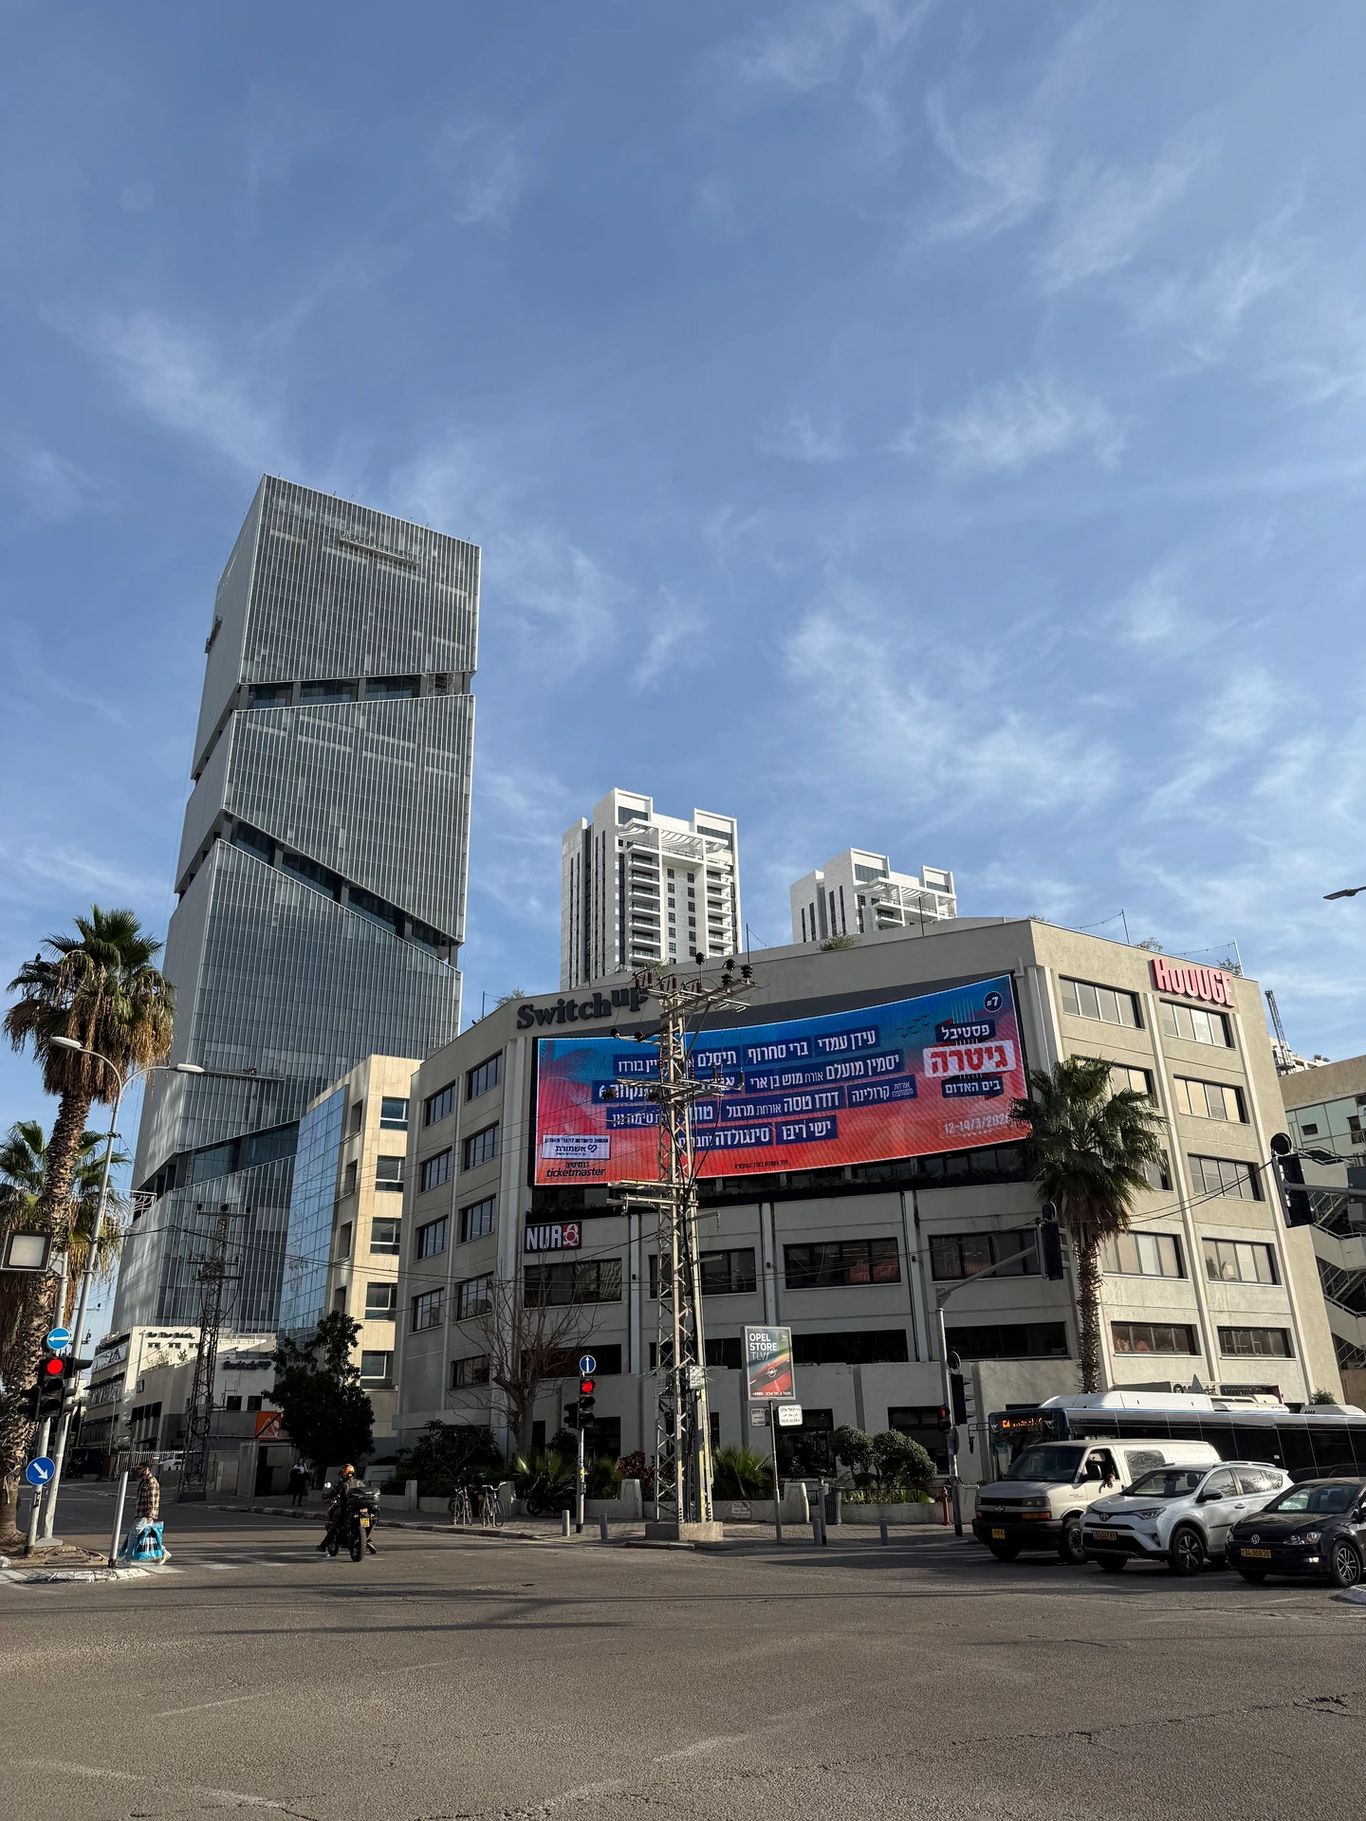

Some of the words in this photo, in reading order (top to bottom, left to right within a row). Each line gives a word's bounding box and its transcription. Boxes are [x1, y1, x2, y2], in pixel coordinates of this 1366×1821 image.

[849, 1029, 876, 1051] עידן
[941, 1024, 990, 1040] פסטיבל
[787, 1041, 809, 1057] ברי
[817, 1034, 848, 1052] עמדי
[697, 1050, 737, 1068] תיסלם
[748, 1043, 786, 1065] סחרוף
[931, 1044, 1009, 1074] גיטרה
[826, 1060, 864, 1080] מועלם
[867, 1054, 900, 1074] יסמין
[750, 1077, 767, 1089] ארי
[769, 1076, 780, 1089] בן
[782, 1073, 803, 1086] מוש
[805, 1071, 824, 1083] אורח
[852, 1085, 890, 1103] קרולינה
[945, 1082, 979, 1094] האדום
[981, 1080, 1001, 1092] בים
[784, 1096, 813, 1113] טסה
[814, 1091, 839, 1109] דודו
[726, 1105, 755, 1119] מרגול
[756, 1103, 782, 1116] אורחת
[715, 1127, 770, 1146] סינגולדה
[782, 1122, 807, 1140] ריבו
[808, 1120, 831, 1137] ישי
[546, 1167, 606, 1178] ticketmaster
[526, 1225, 562, 1251] NUR
[749, 1333, 771, 1342] OPEL
[749, 1342, 778, 1351] STORE
